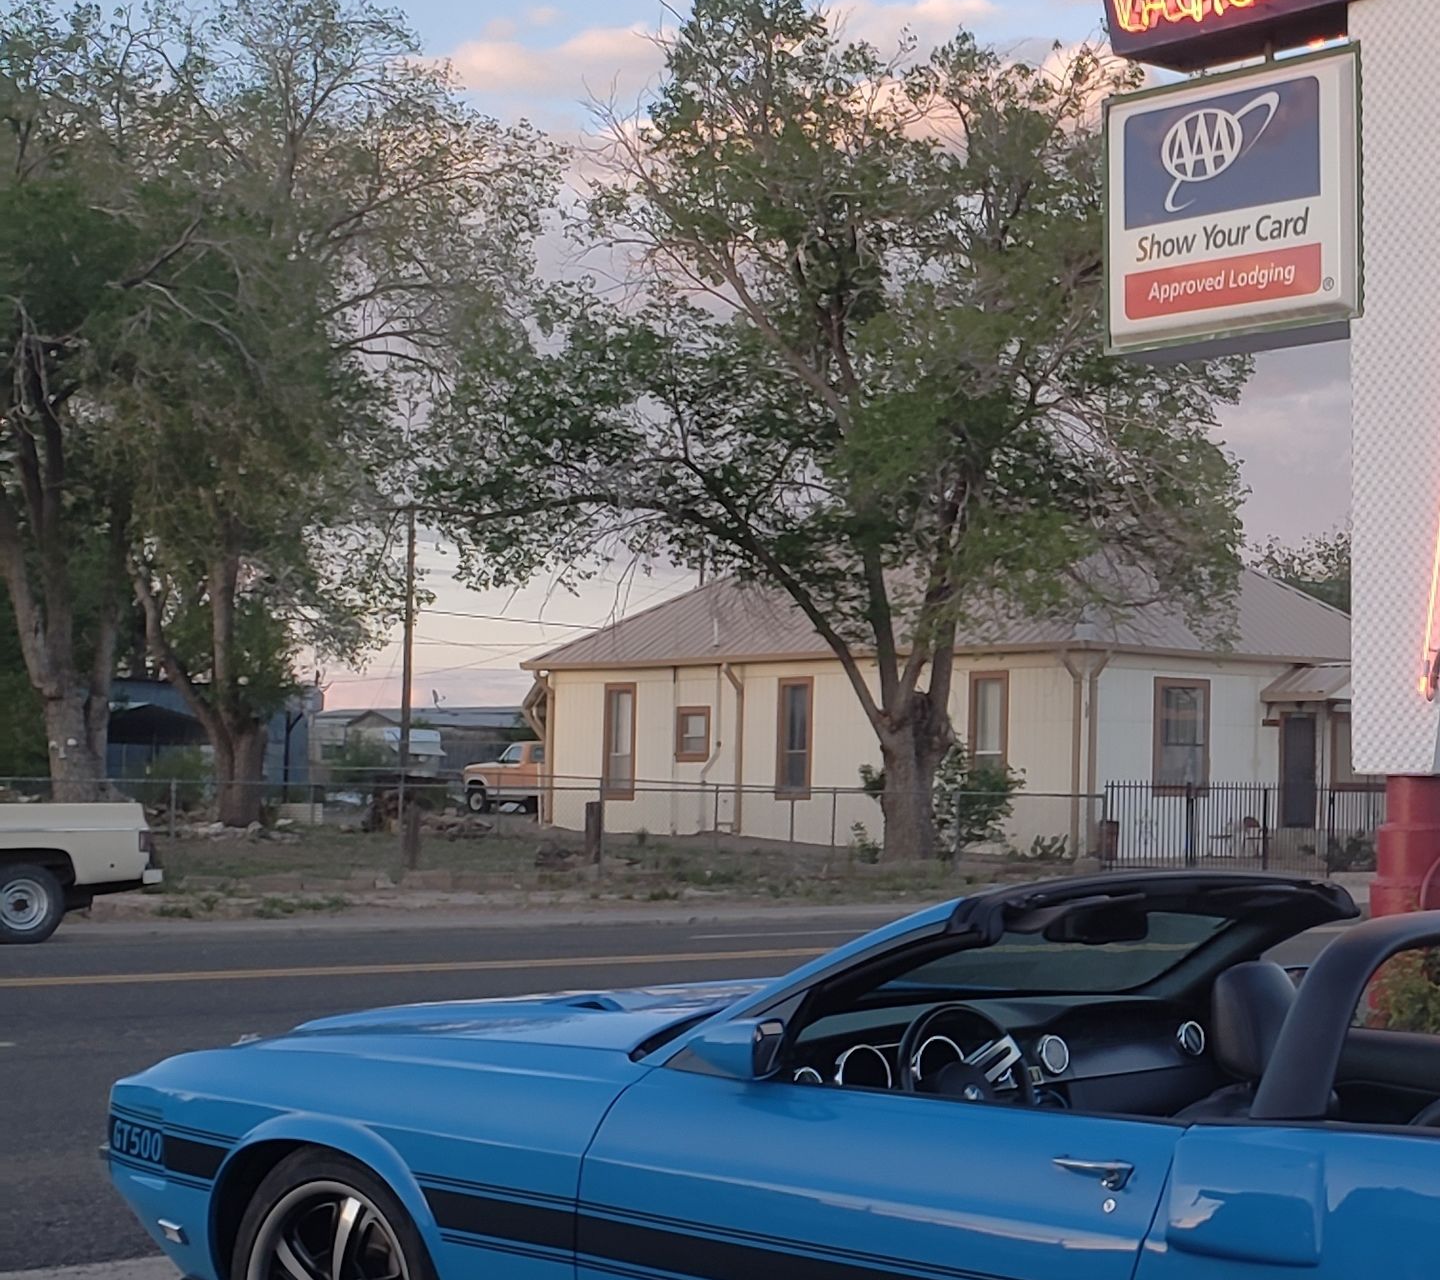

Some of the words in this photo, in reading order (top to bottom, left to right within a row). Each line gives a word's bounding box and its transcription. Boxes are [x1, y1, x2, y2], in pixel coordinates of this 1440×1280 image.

[1172, 111, 1235, 178] AAA
[1136, 232, 1197, 262] Show
[1202, 222, 1251, 251] Your
[1256, 207, 1310, 243] Card
[1148, 270, 1225, 304] Approved
[1229, 263, 1296, 290] Lodging
[112, 1120, 163, 1162] GT500
